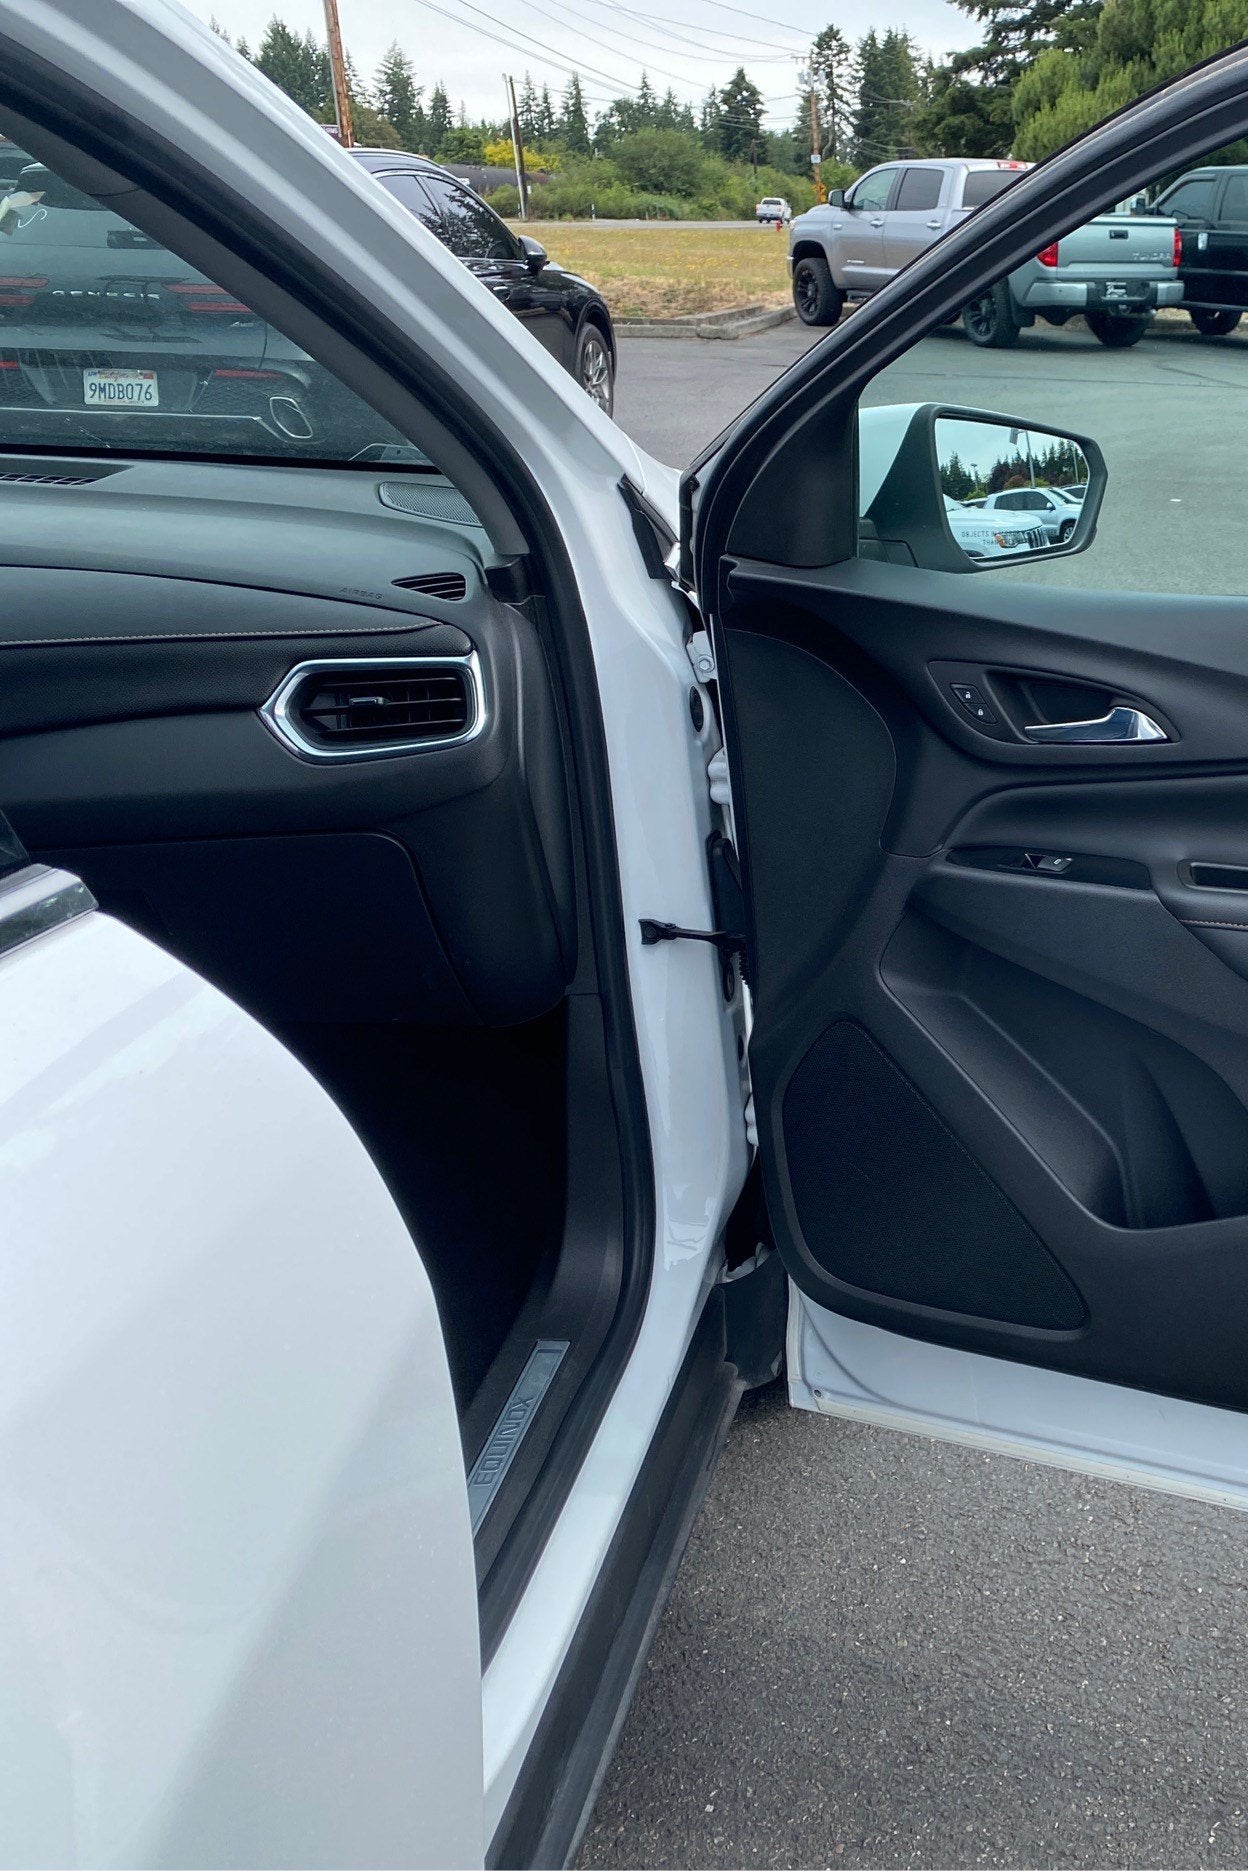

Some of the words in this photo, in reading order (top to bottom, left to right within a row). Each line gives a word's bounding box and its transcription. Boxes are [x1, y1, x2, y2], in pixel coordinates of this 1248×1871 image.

[52, 290, 160, 299] GENESIS
[89, 382, 153, 401] 9MDB076
[961, 530, 990, 538] OBJECTS
[472, 1397, 534, 1487] EQUINOX
